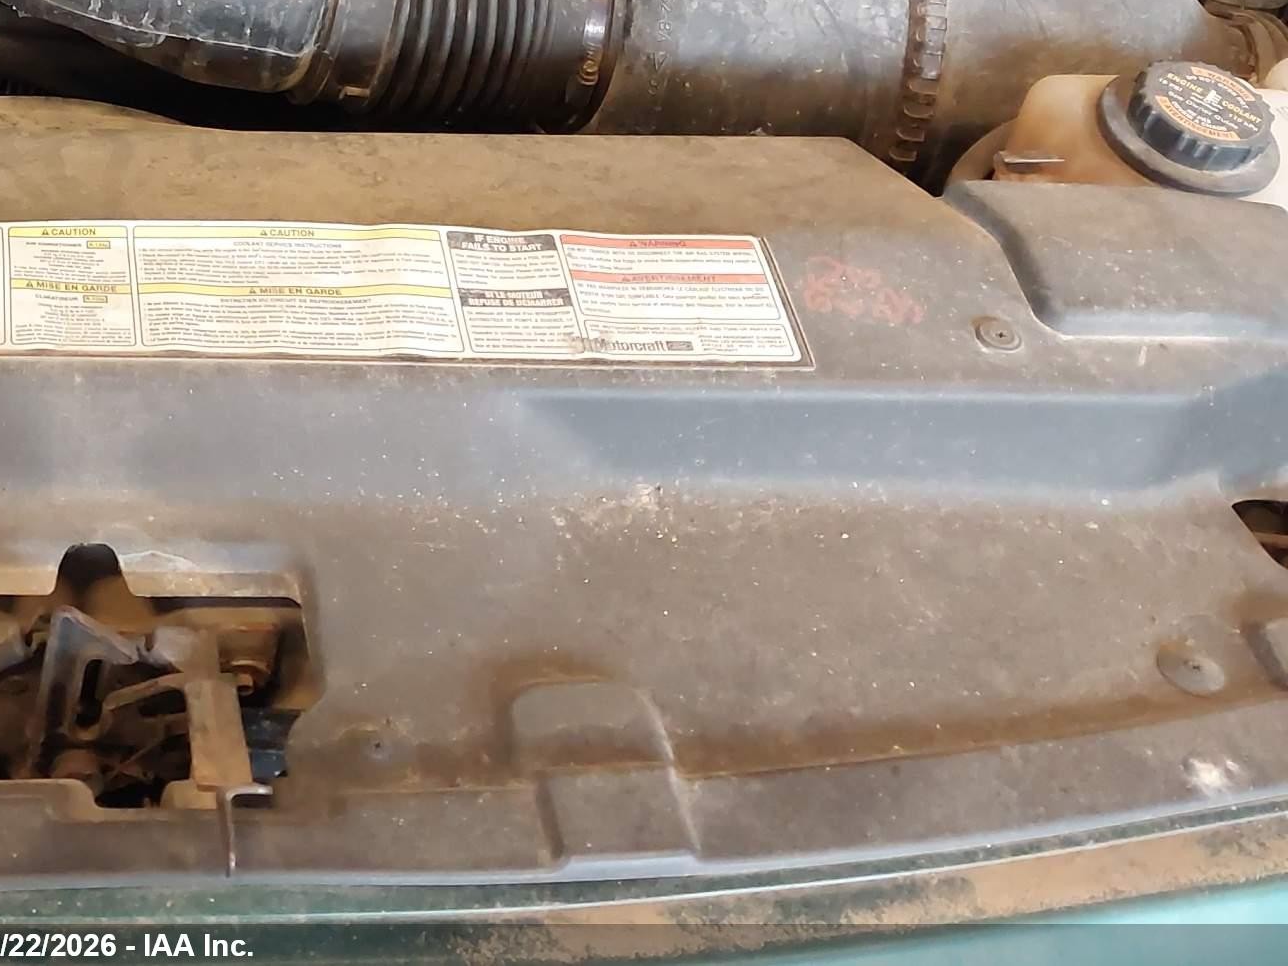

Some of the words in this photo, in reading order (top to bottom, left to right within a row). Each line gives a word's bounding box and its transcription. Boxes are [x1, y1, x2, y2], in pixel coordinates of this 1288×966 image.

[1166, 72, 1204, 94] ENGINE
[1222, 100, 1262, 124] COOLANT
[51, 228, 97, 236] CAUTION
[269, 229, 315, 237] CAUTION
[474, 234, 485, 242] IF
[486, 235, 525, 244] ENGINE
[461, 242, 490, 251] FAILS
[492, 244, 507, 252] TO
[509, 243, 542, 252] START
[36, 281, 62, 290] MISE
[64, 282, 78, 291] EN
[81, 283, 118, 292] GARDE
[507, 290, 544, 299] MOTEUR
[468, 298, 501, 307] REFUSE
[502, 298, 514, 307] DE
